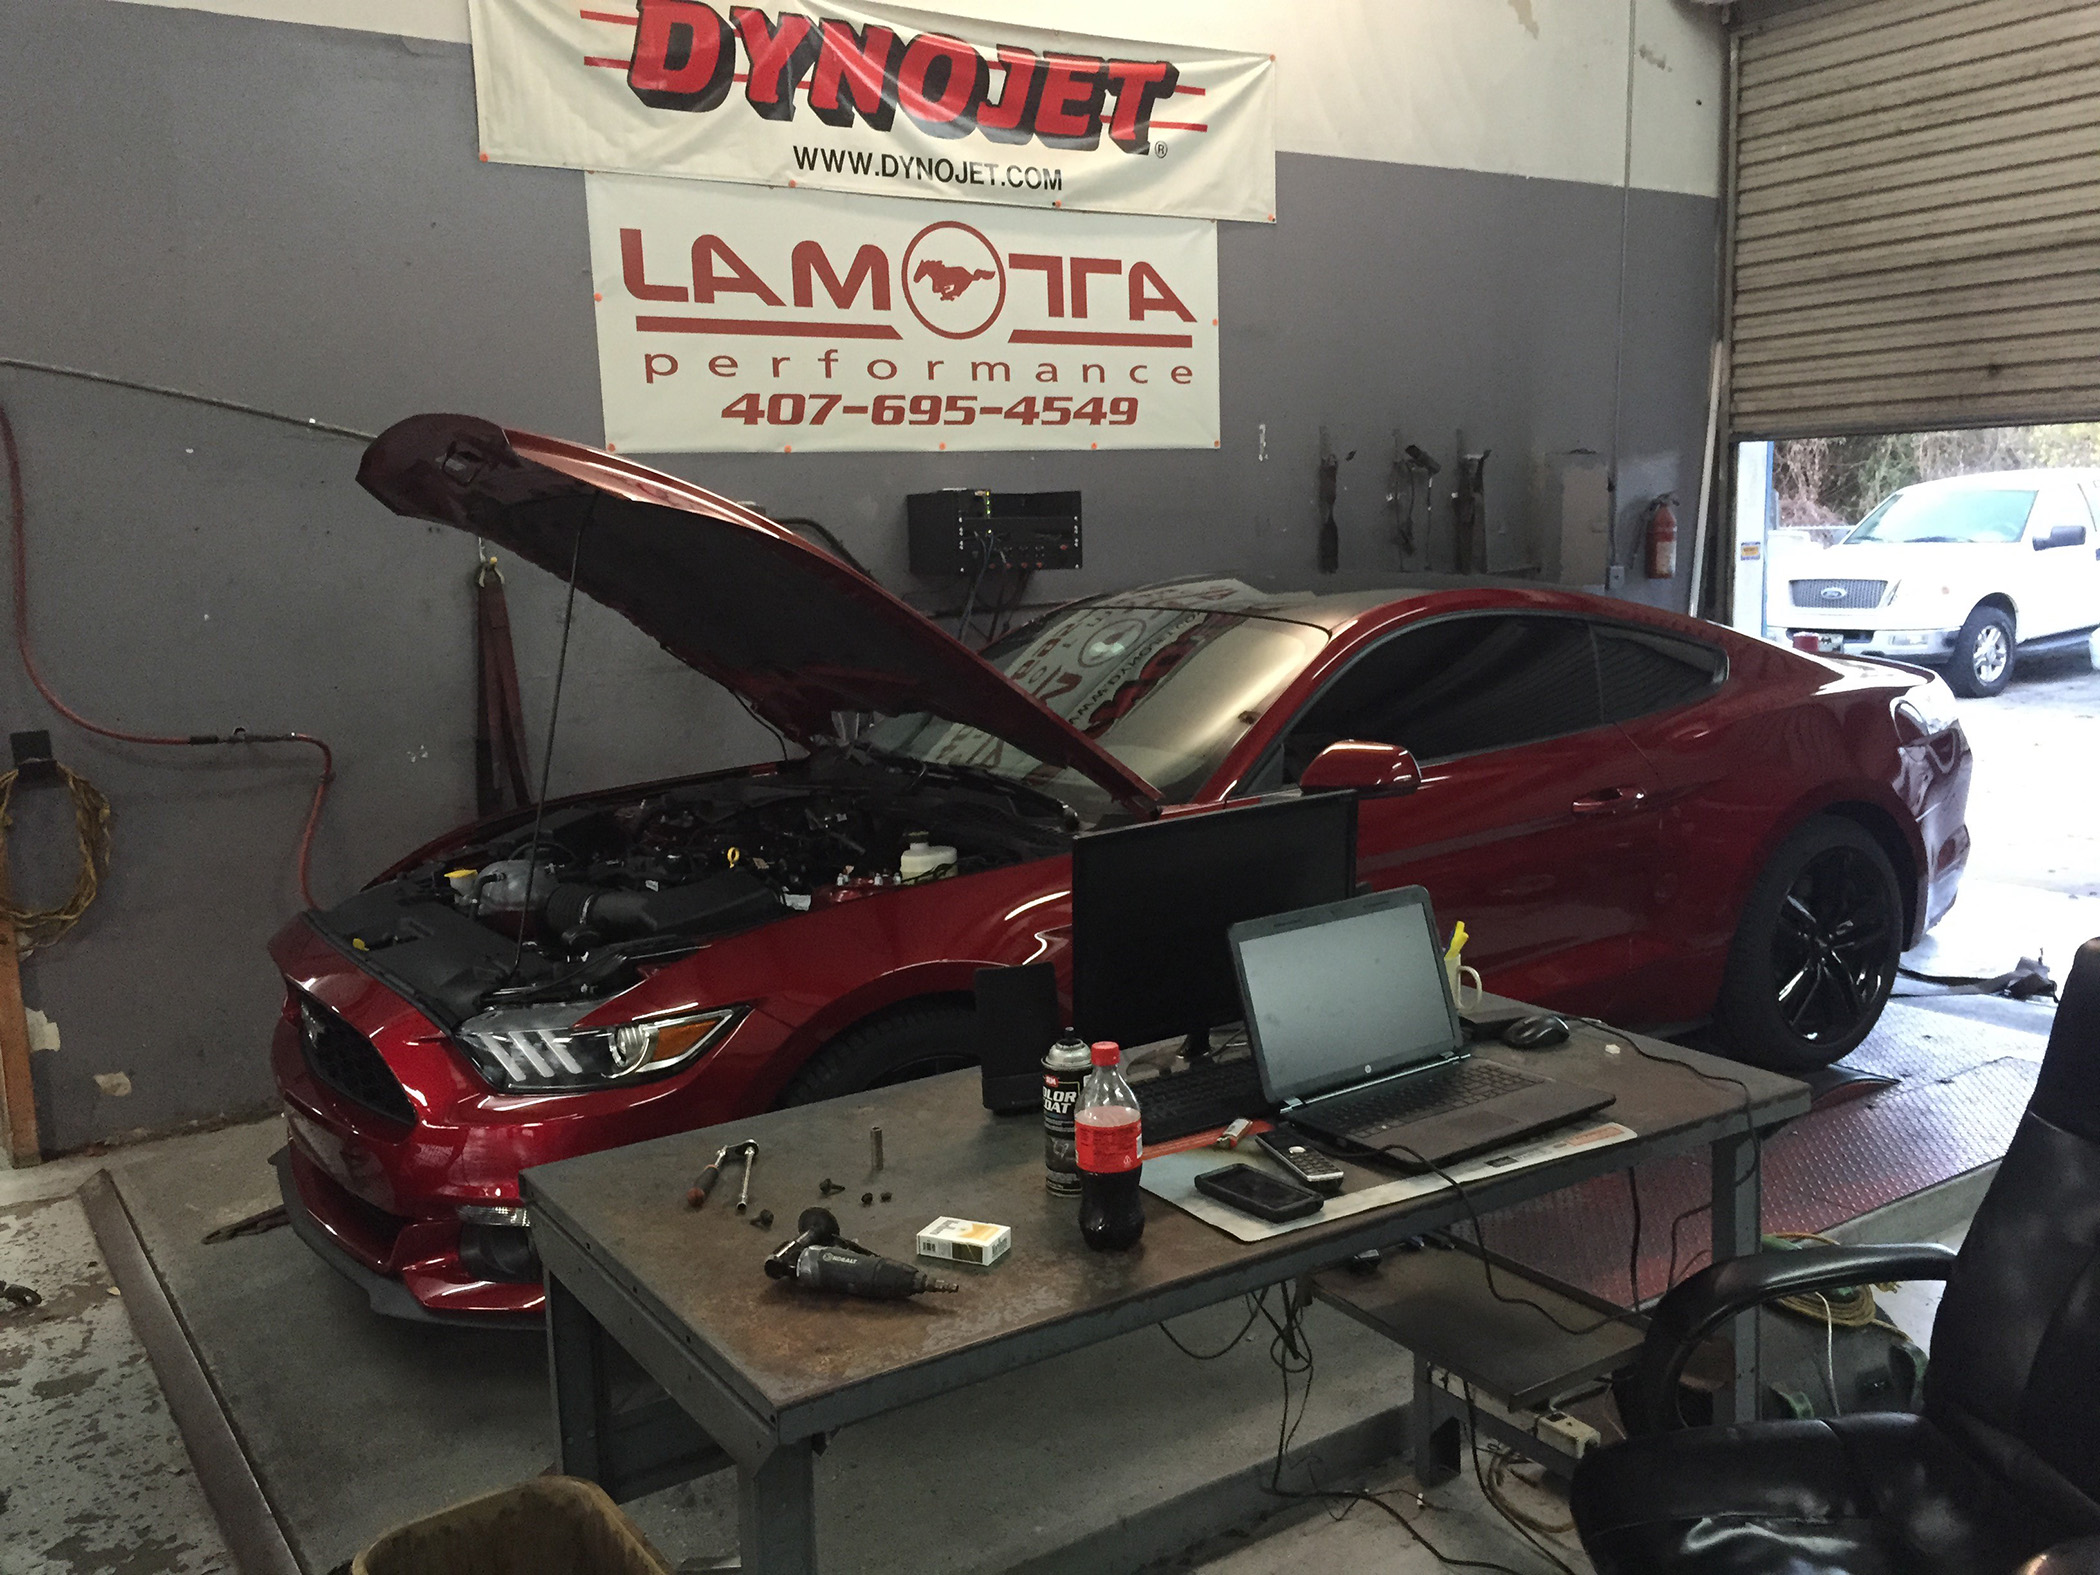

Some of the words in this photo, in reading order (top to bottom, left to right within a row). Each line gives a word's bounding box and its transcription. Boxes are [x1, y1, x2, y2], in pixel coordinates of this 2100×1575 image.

[627, 0, 1180, 156] DYNOJET
[792, 145, 1063, 192] WWW.DYNOJET.COM
[643, 350, 1194, 386] performance
[721, 393, 1139, 427] 407-695-4549
